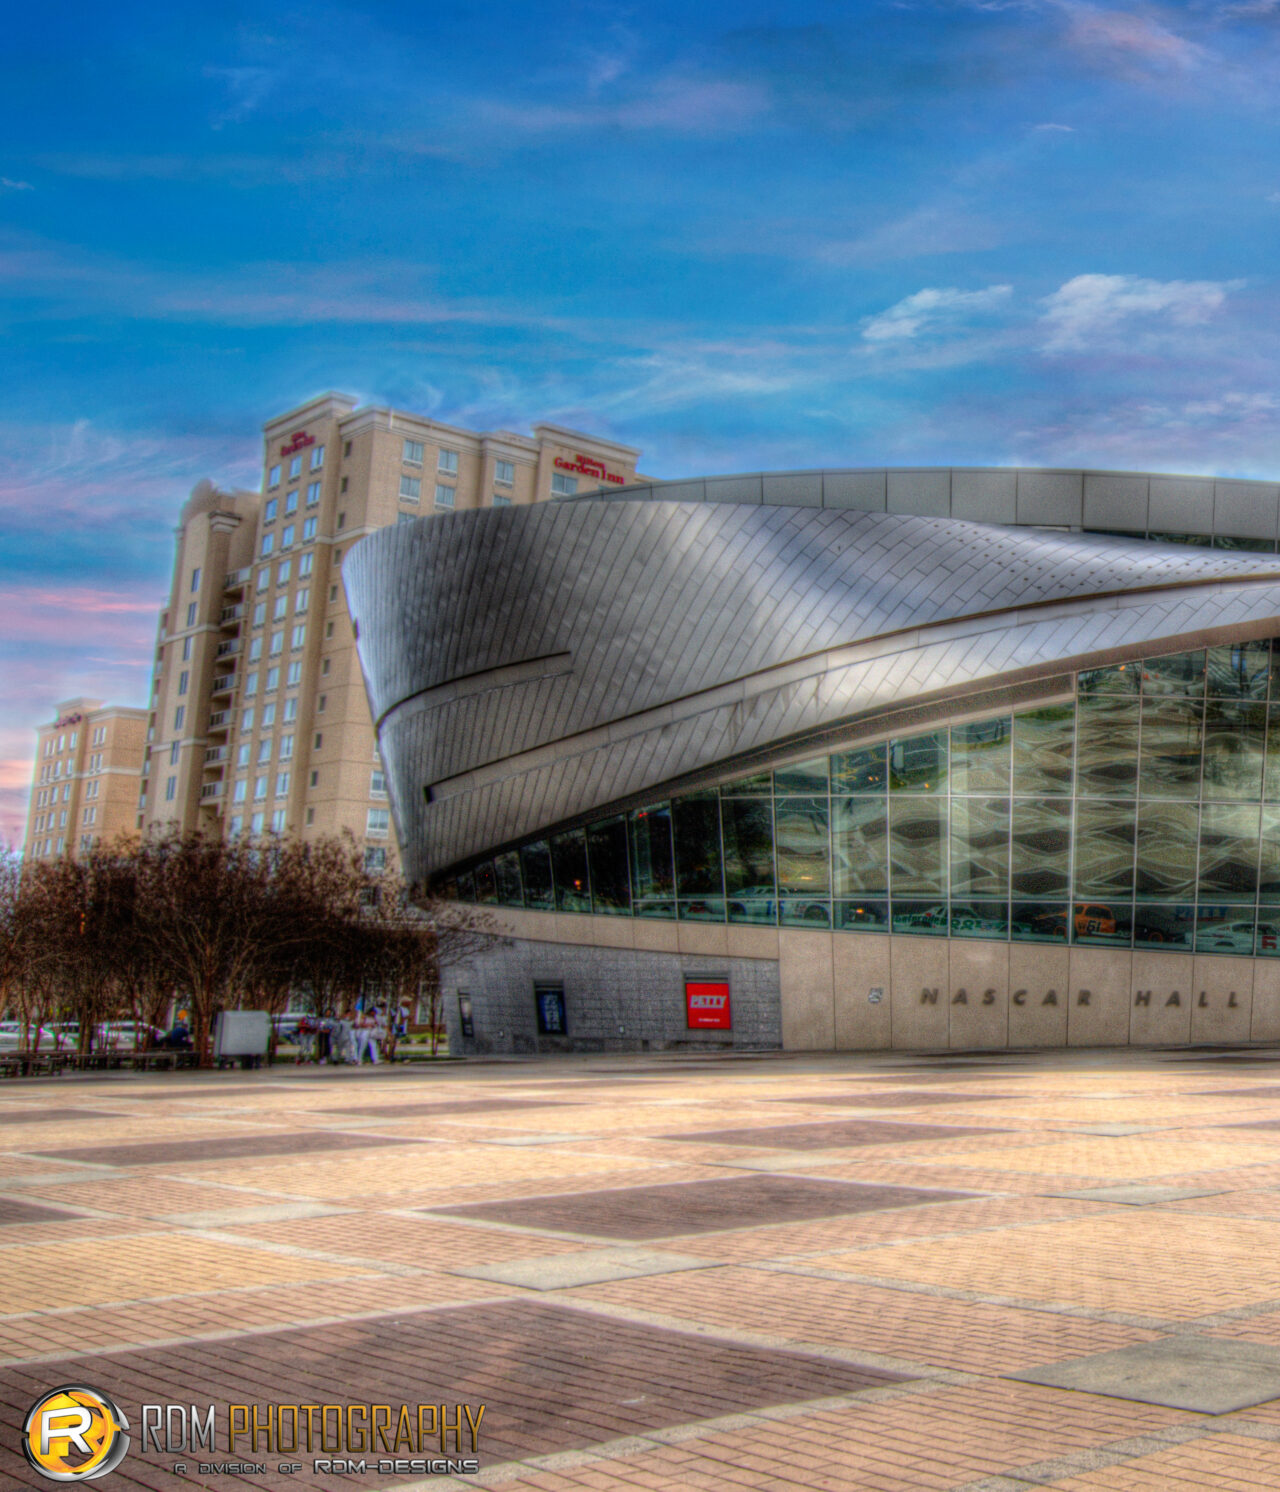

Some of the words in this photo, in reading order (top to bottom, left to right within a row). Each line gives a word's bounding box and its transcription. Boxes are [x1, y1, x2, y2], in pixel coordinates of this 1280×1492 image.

[554, 457, 600, 478] Garden
[602, 464, 624, 485] Inn
[690, 995, 727, 1009] PETTY
[919, 987, 1092, 1007] NASCAR
[1134, 989, 1239, 1009] HALL
